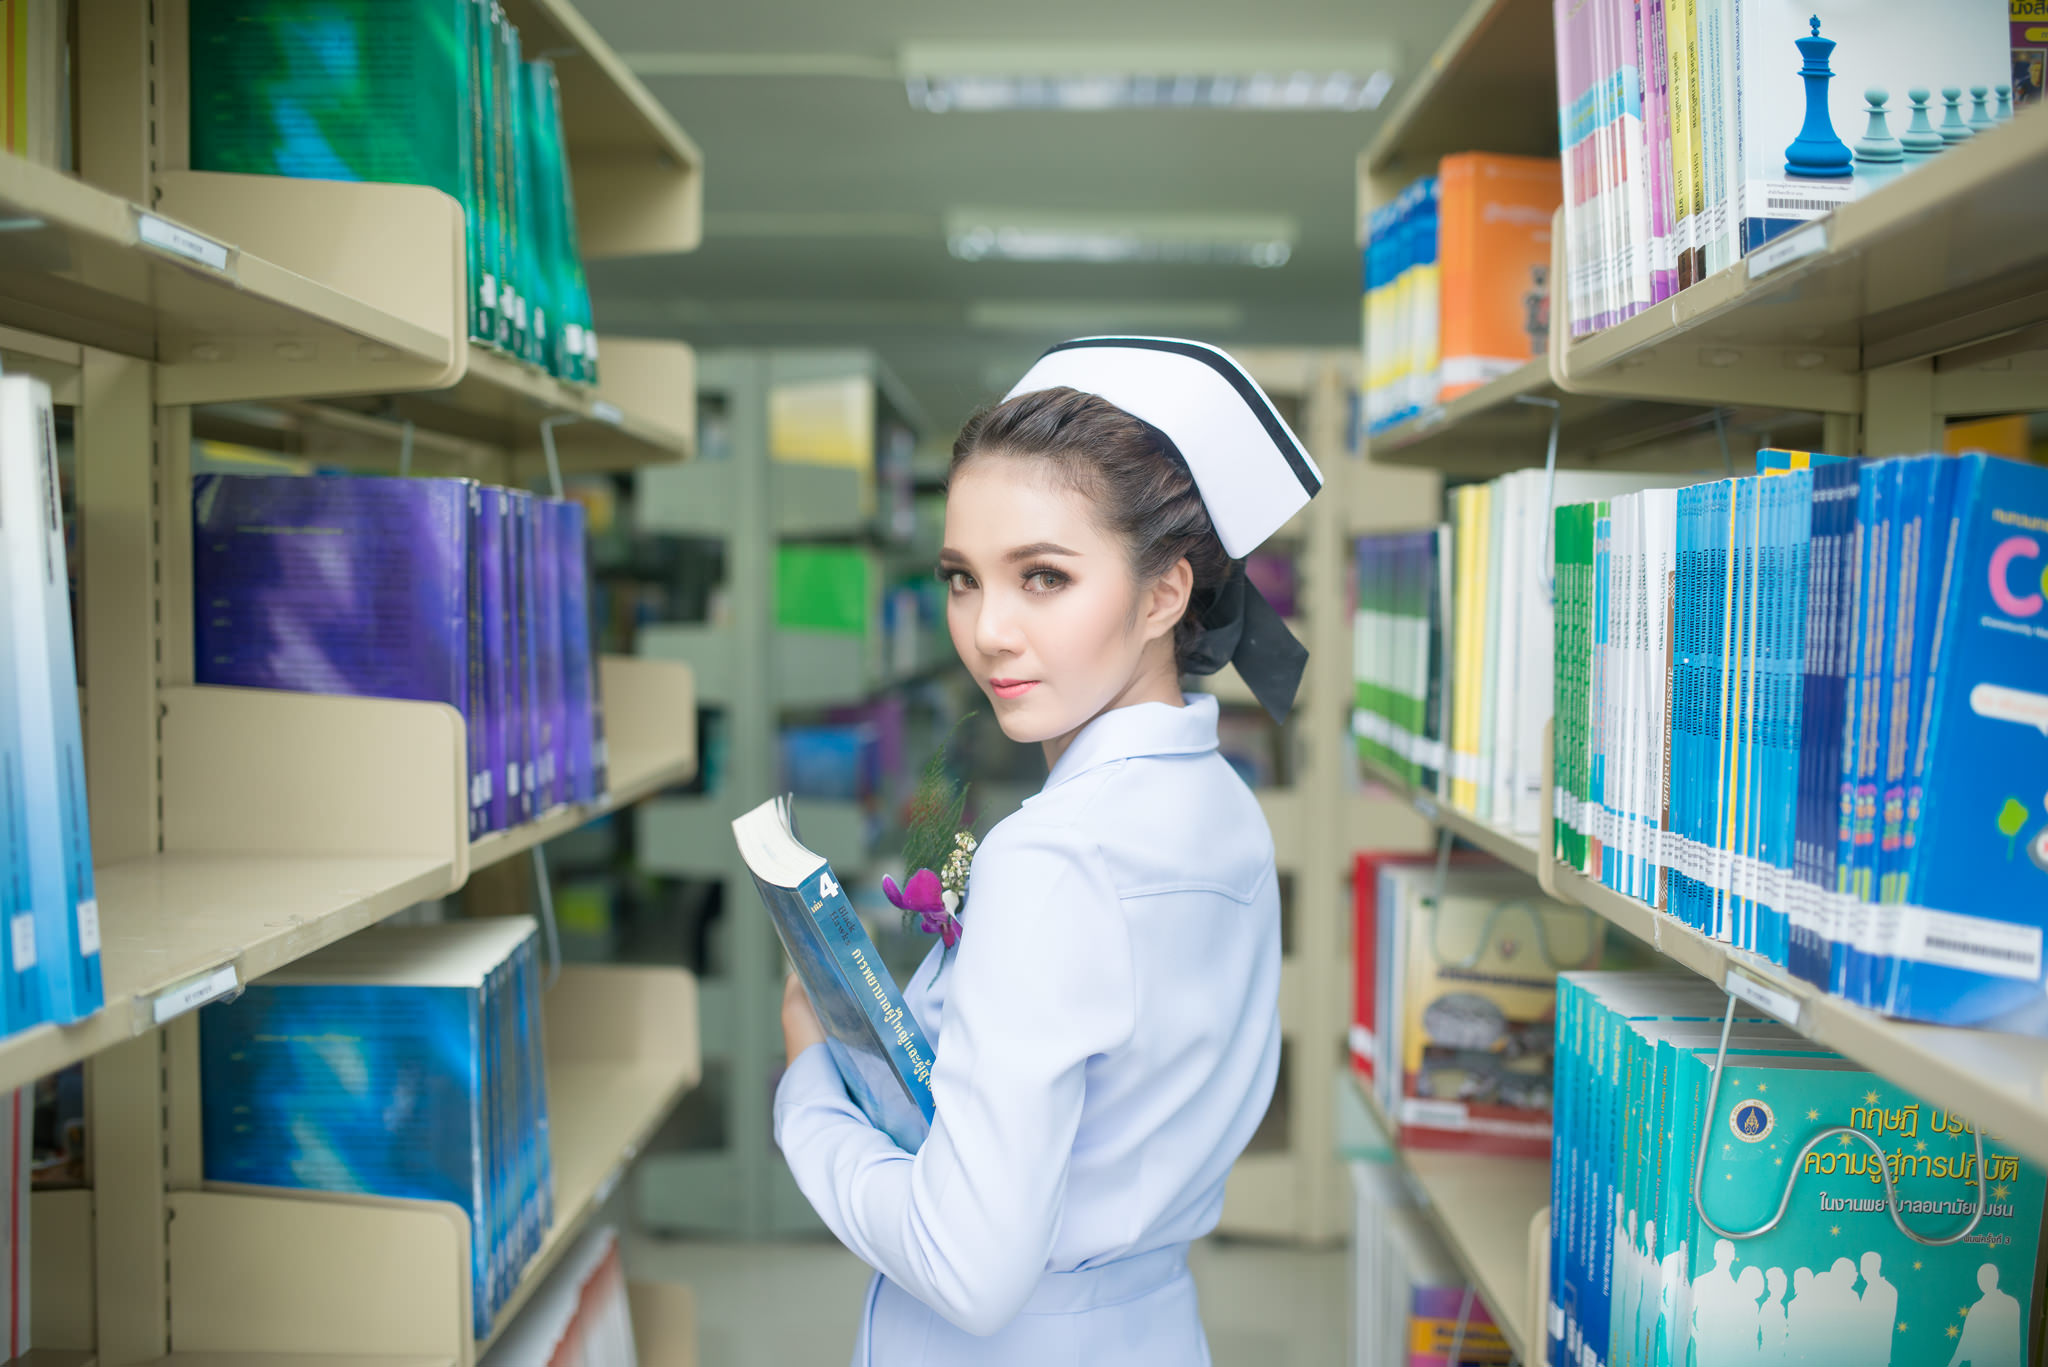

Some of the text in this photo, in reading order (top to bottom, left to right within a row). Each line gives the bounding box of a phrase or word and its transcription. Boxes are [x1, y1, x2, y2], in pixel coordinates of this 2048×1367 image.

[820, 872, 839, 899] 4
[830, 911, 851, 946] Hawks
[838, 905, 856, 933] Black
[1850, 1104, 1919, 1138] ทฤษฎี
